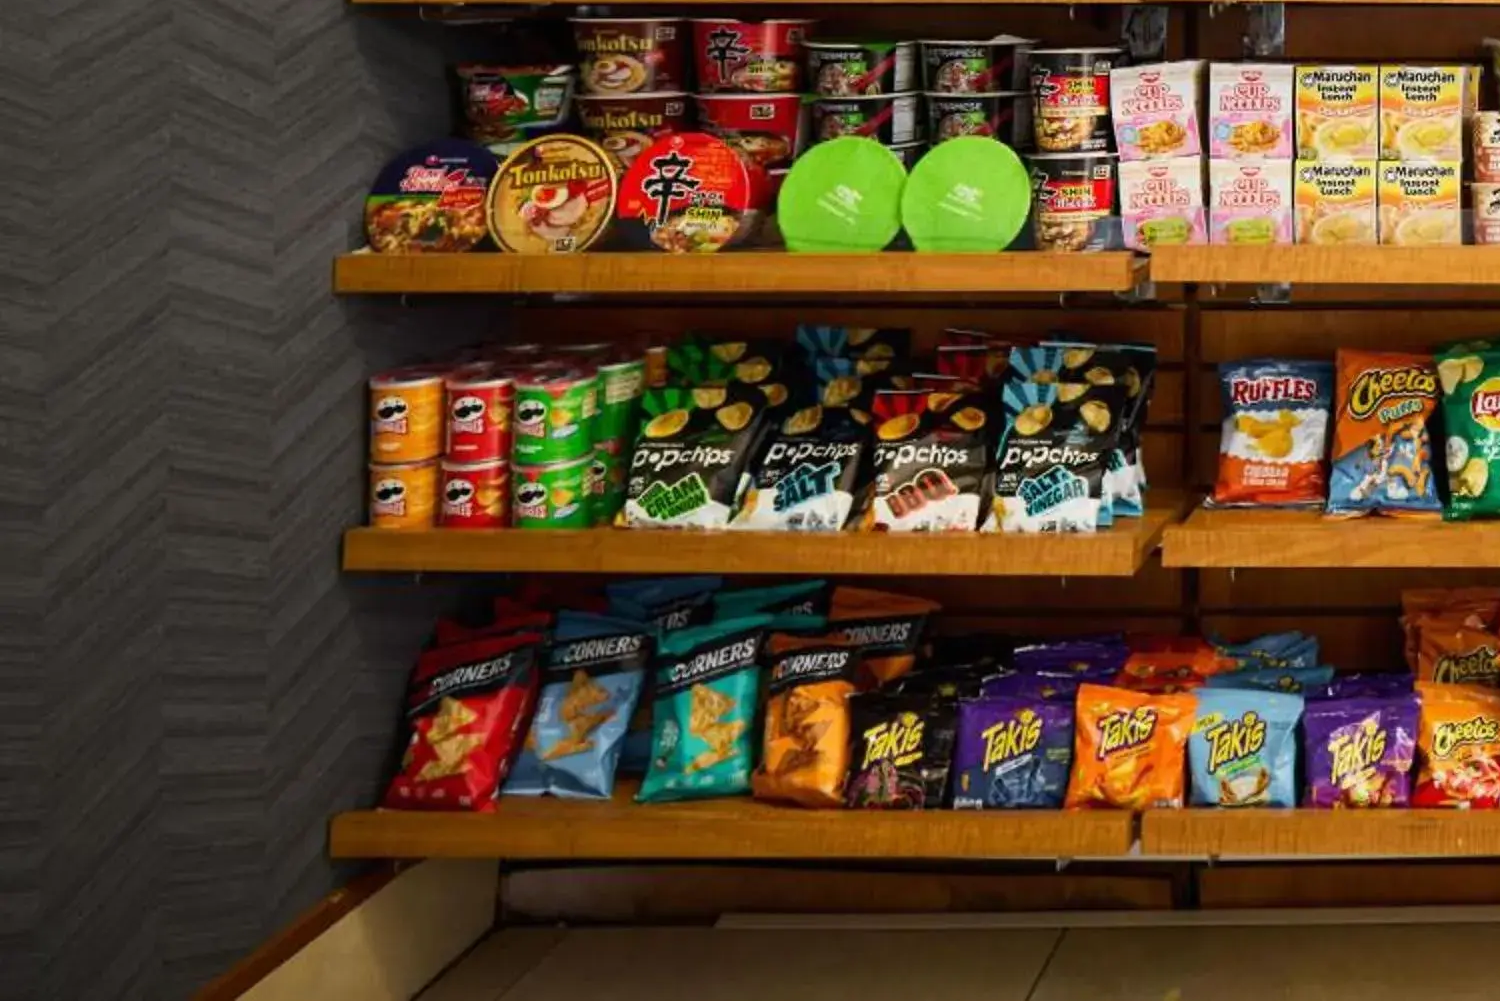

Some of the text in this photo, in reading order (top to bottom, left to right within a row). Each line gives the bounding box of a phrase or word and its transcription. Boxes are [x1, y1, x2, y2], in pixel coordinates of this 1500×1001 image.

[706, 25, 751, 86] 辛
[1234, 83, 1270, 97] CUP
[1313, 71, 1371, 83] Maruchan
[1398, 71, 1455, 84] Maruchan
[1136, 84, 1170, 97] CUP
[1219, 95, 1282, 112] NOODLES
[1122, 95, 1185, 115] NOODLES
[510, 161, 605, 188] Tonkotsu
[1233, 178, 1269, 192] CUP
[1311, 166, 1371, 178] Maruchan
[1396, 166, 1454, 178] Maruchan
[642, 150, 703, 227] 辛
[1130, 191, 1192, 208] NOODLES
[1142, 180, 1176, 193] CUP
[1219, 191, 1282, 208] NOODLES
[1231, 378, 1318, 405] RUFFLES
[1350, 368, 1437, 418] Cheetos
[1379, 399, 1423, 423] Puffs
[631, 445, 733, 471] popchips
[763, 442, 859, 465] popchips
[1000, 447, 1099, 468] popchips
[1025, 477, 1087, 516] VINEGAR
[563, 635, 642, 664] CORNERS
[670, 637, 756, 683] CORNERS
[432, 655, 512, 691] CORNERS
[776, 651, 849, 679] CORNERS
[1434, 647, 1500, 684] Cheeto
[863, 713, 924, 769] Takis
[982, 710, 1042, 768] Takis
[1097, 706, 1157, 760] Takis
[1207, 711, 1268, 773] Takis
[1328, 721, 1387, 779] Takis
